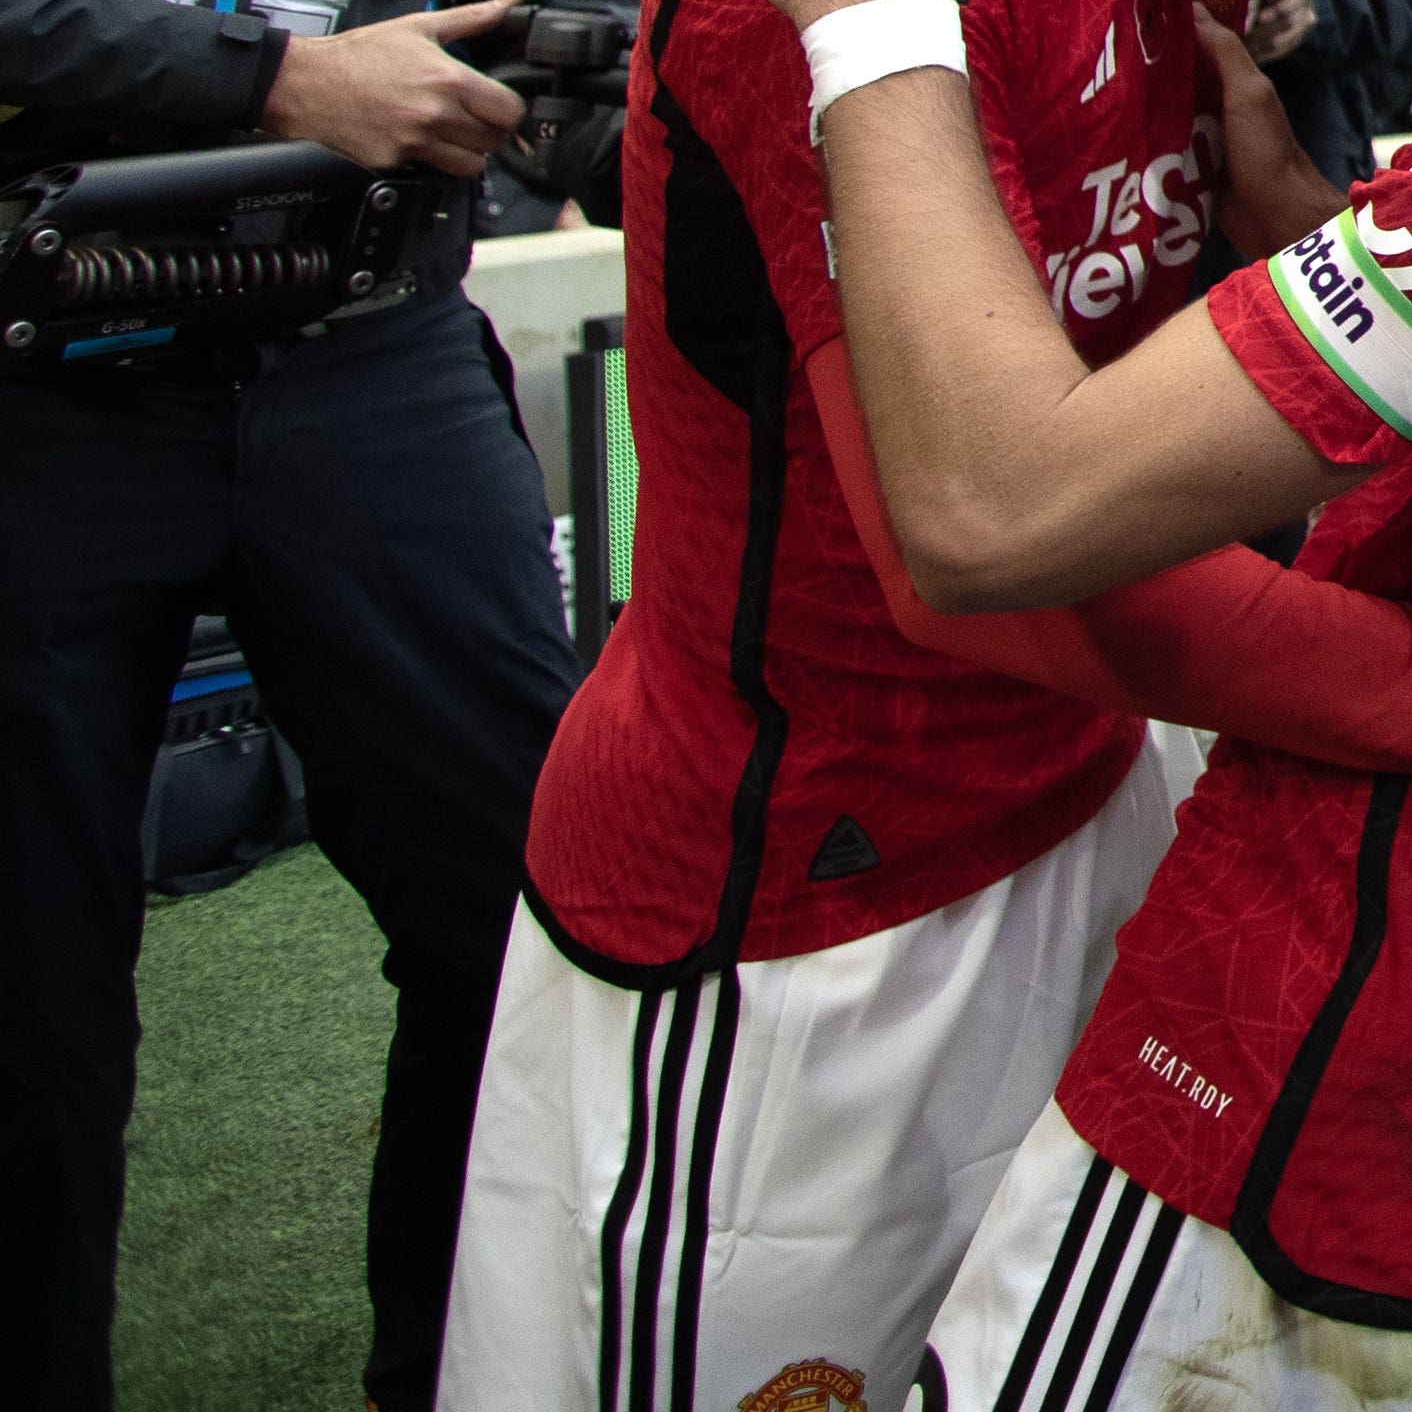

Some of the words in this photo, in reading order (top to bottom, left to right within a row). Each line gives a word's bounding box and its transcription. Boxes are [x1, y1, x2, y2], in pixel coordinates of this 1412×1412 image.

[1283, 229, 1375, 345] ptain
[1138, 1036, 1235, 1119] HEAT.RDY
[756, 1367, 854, 1412] ANCHESTER
